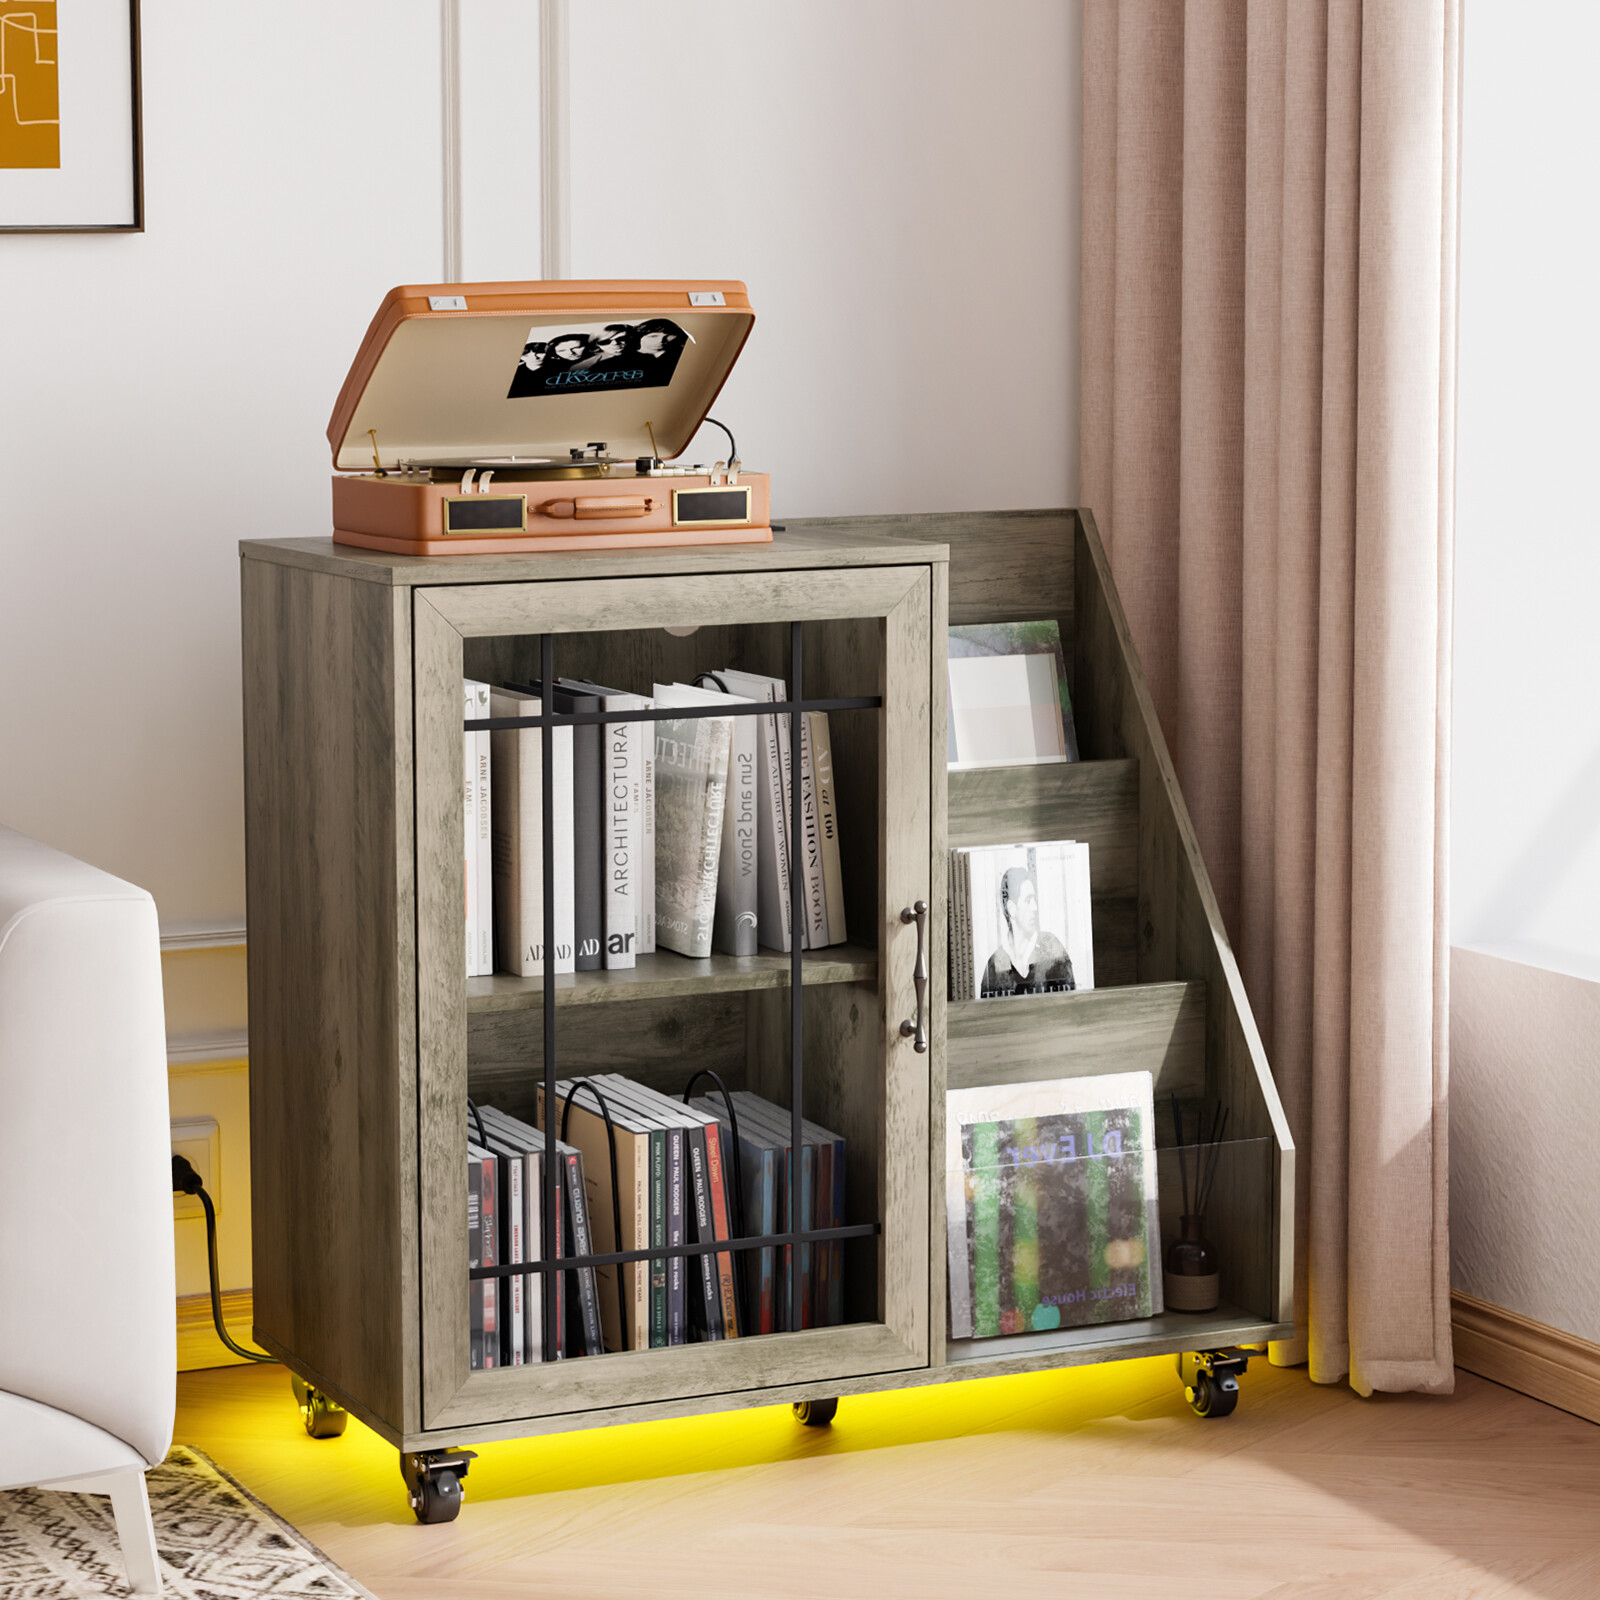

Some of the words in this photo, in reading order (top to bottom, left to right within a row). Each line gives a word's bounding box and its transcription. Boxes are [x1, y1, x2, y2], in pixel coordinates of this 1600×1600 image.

[769, 737, 777, 764] THE
[479, 755, 487, 781] ARNE
[772, 766, 781, 817] ALLURE
[816, 745, 830, 784] AD
[824, 813, 834, 839] 100
[479, 786, 488, 839] JACOBSEN
[776, 819, 784, 837] OF
[778, 840, 788, 891] WOMEN
[802, 776, 818, 868] FASHION
[810, 876, 823, 931] BOOK
[578, 938, 600, 956] AD
[607, 932, 635, 955] ar
[693, 1147, 701, 1172] QUEEN
[708, 1137, 718, 1158] Steel
[711, 1159, 720, 1183] Dawn
[696, 1178, 704, 1195] PAUL
[698, 1195, 707, 1227] RODGERS
